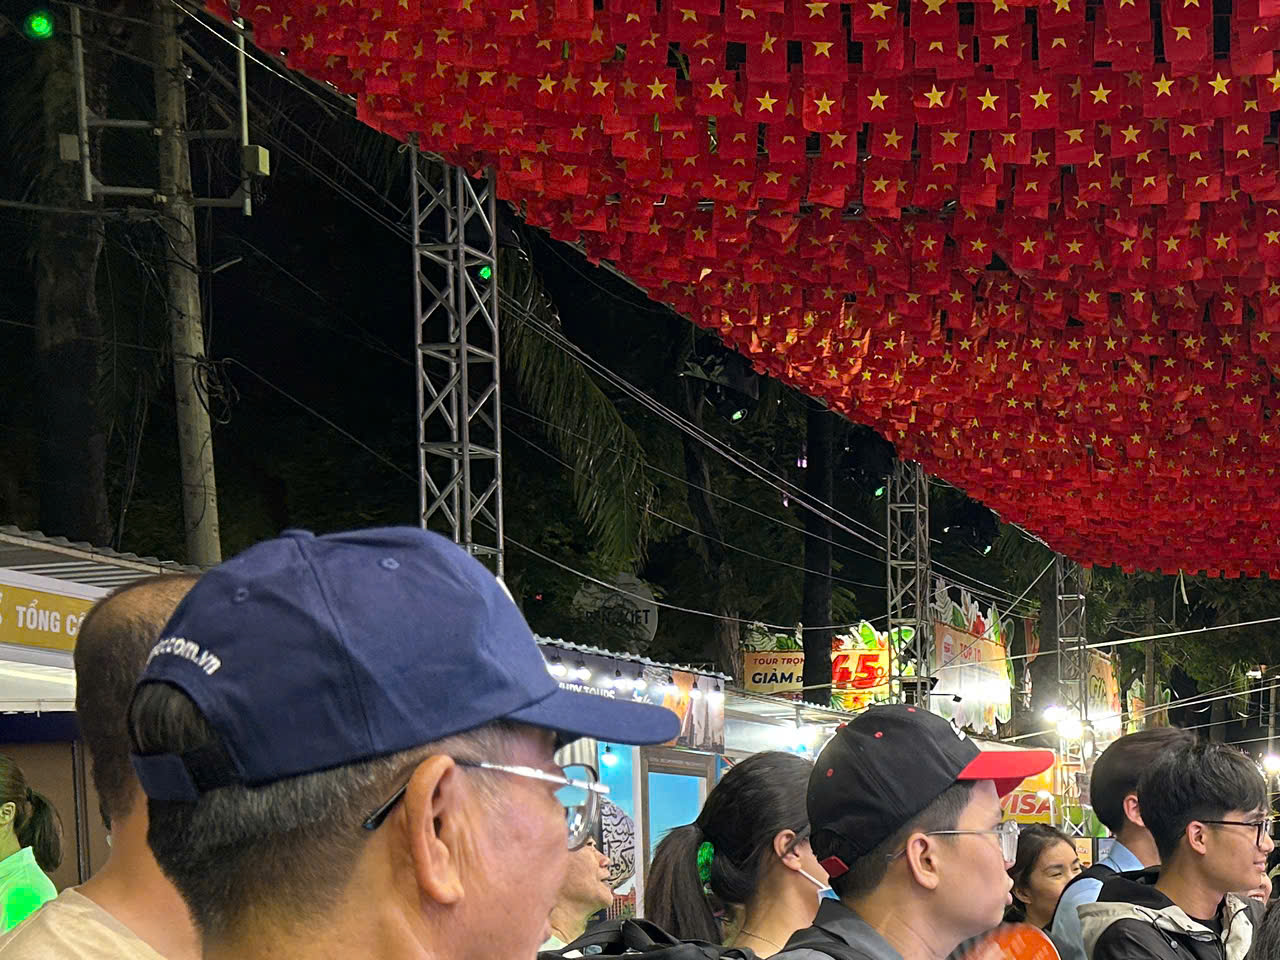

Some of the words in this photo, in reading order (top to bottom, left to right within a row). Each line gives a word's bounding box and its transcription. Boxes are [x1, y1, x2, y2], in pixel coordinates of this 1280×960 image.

[15, 599, 61, 633] TỔNG
[753, 657, 778, 666] TOUR
[751, 668, 793, 684] GIẢM
